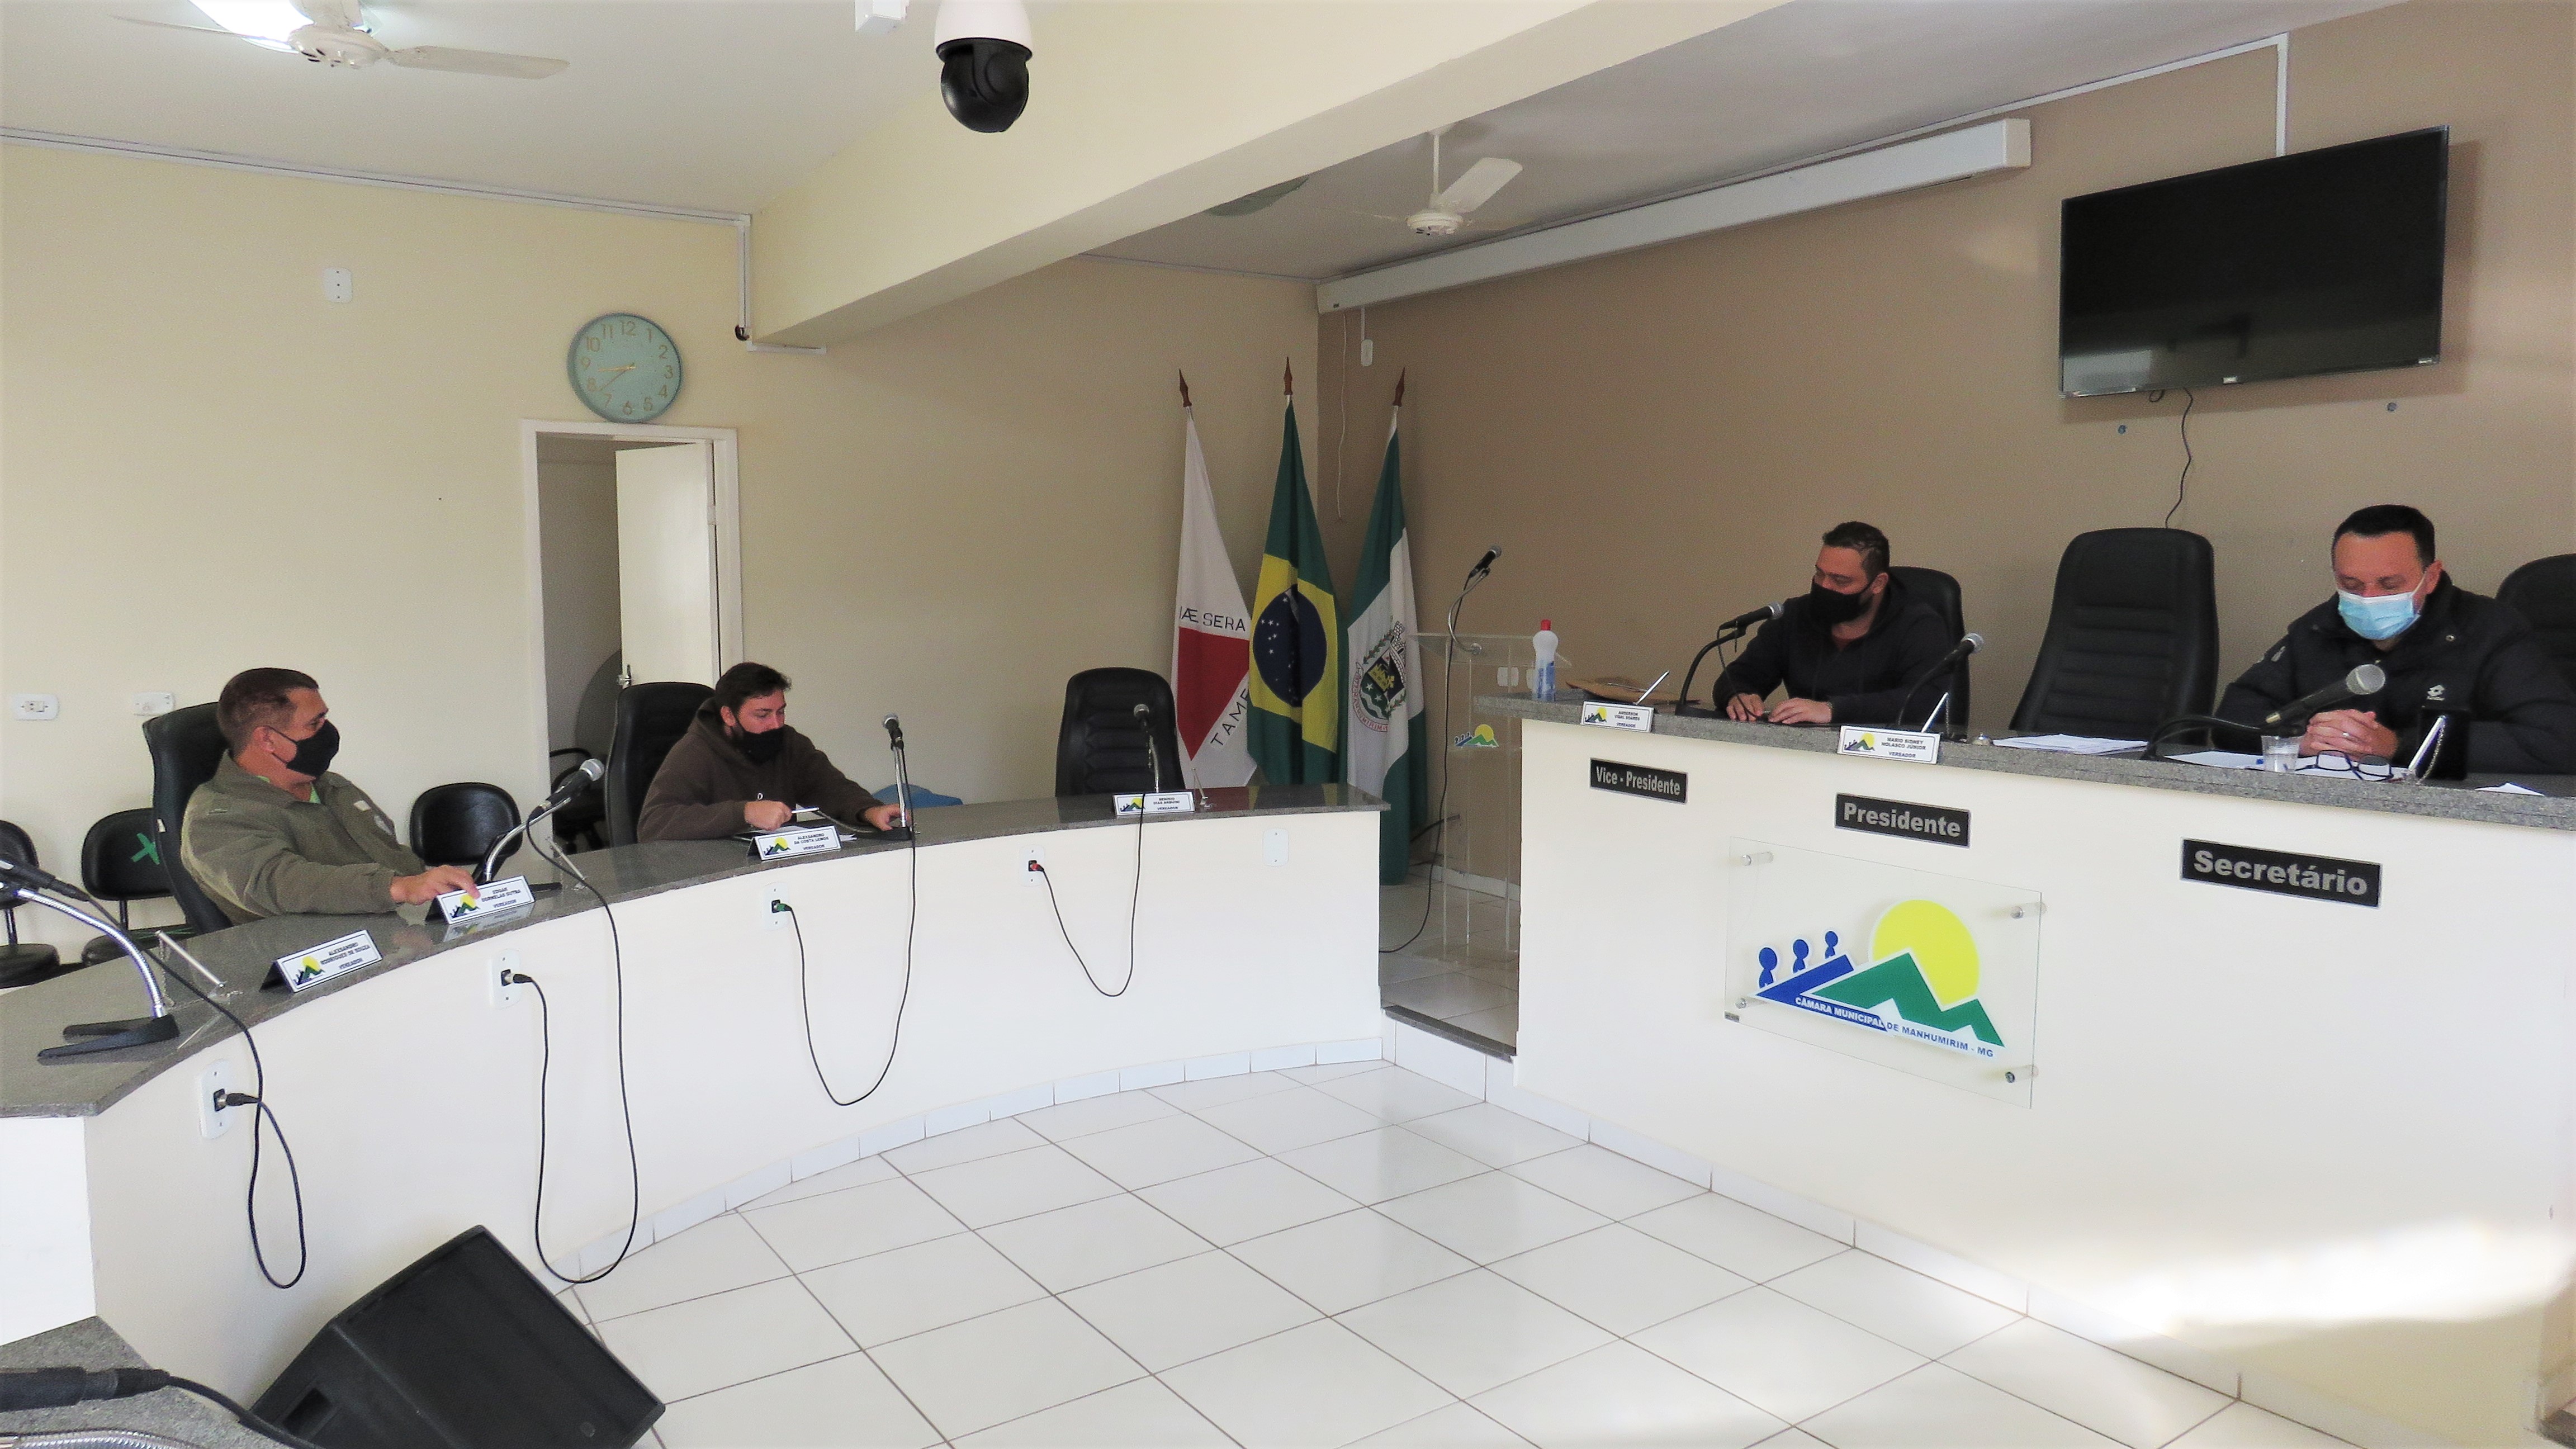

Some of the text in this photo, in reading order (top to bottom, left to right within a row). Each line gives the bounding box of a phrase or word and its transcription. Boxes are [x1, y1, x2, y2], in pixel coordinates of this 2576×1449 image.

[602, 324, 613, 339] 11
[620, 320, 636, 336] 12
[647, 328, 652, 343] 1
[588, 337, 600, 352] 10
[659, 344, 667, 359] 2
[581, 357, 590, 368] 9
[664, 364, 673, 379] 3
[588, 377, 597, 391] 8
[658, 385, 667, 398] 4
[604, 393, 612, 408] 7
[623, 401, 633, 415] 6
[644, 397, 652, 411] 5
[1203, 613, 1246, 631] SERA
[1596, 766, 1618, 784] Vice
[1626, 771, 1680, 795] Presidente
[1844, 803, 1961, 837] Presidente
[2194, 850, 2367, 896] Secretário
[493, 899, 517, 908] VEREADOR
[339, 958, 363, 969] VEREADOR
[1795, 997, 1832, 1014] CÂMARA
[1834, 1007, 1884, 1029] MUNICIPAL
[1887, 1022, 1899, 1032] DE
[1902, 1026, 1968, 1051] MANHUMIRIM
[1977, 1046, 1993, 1058] MG
